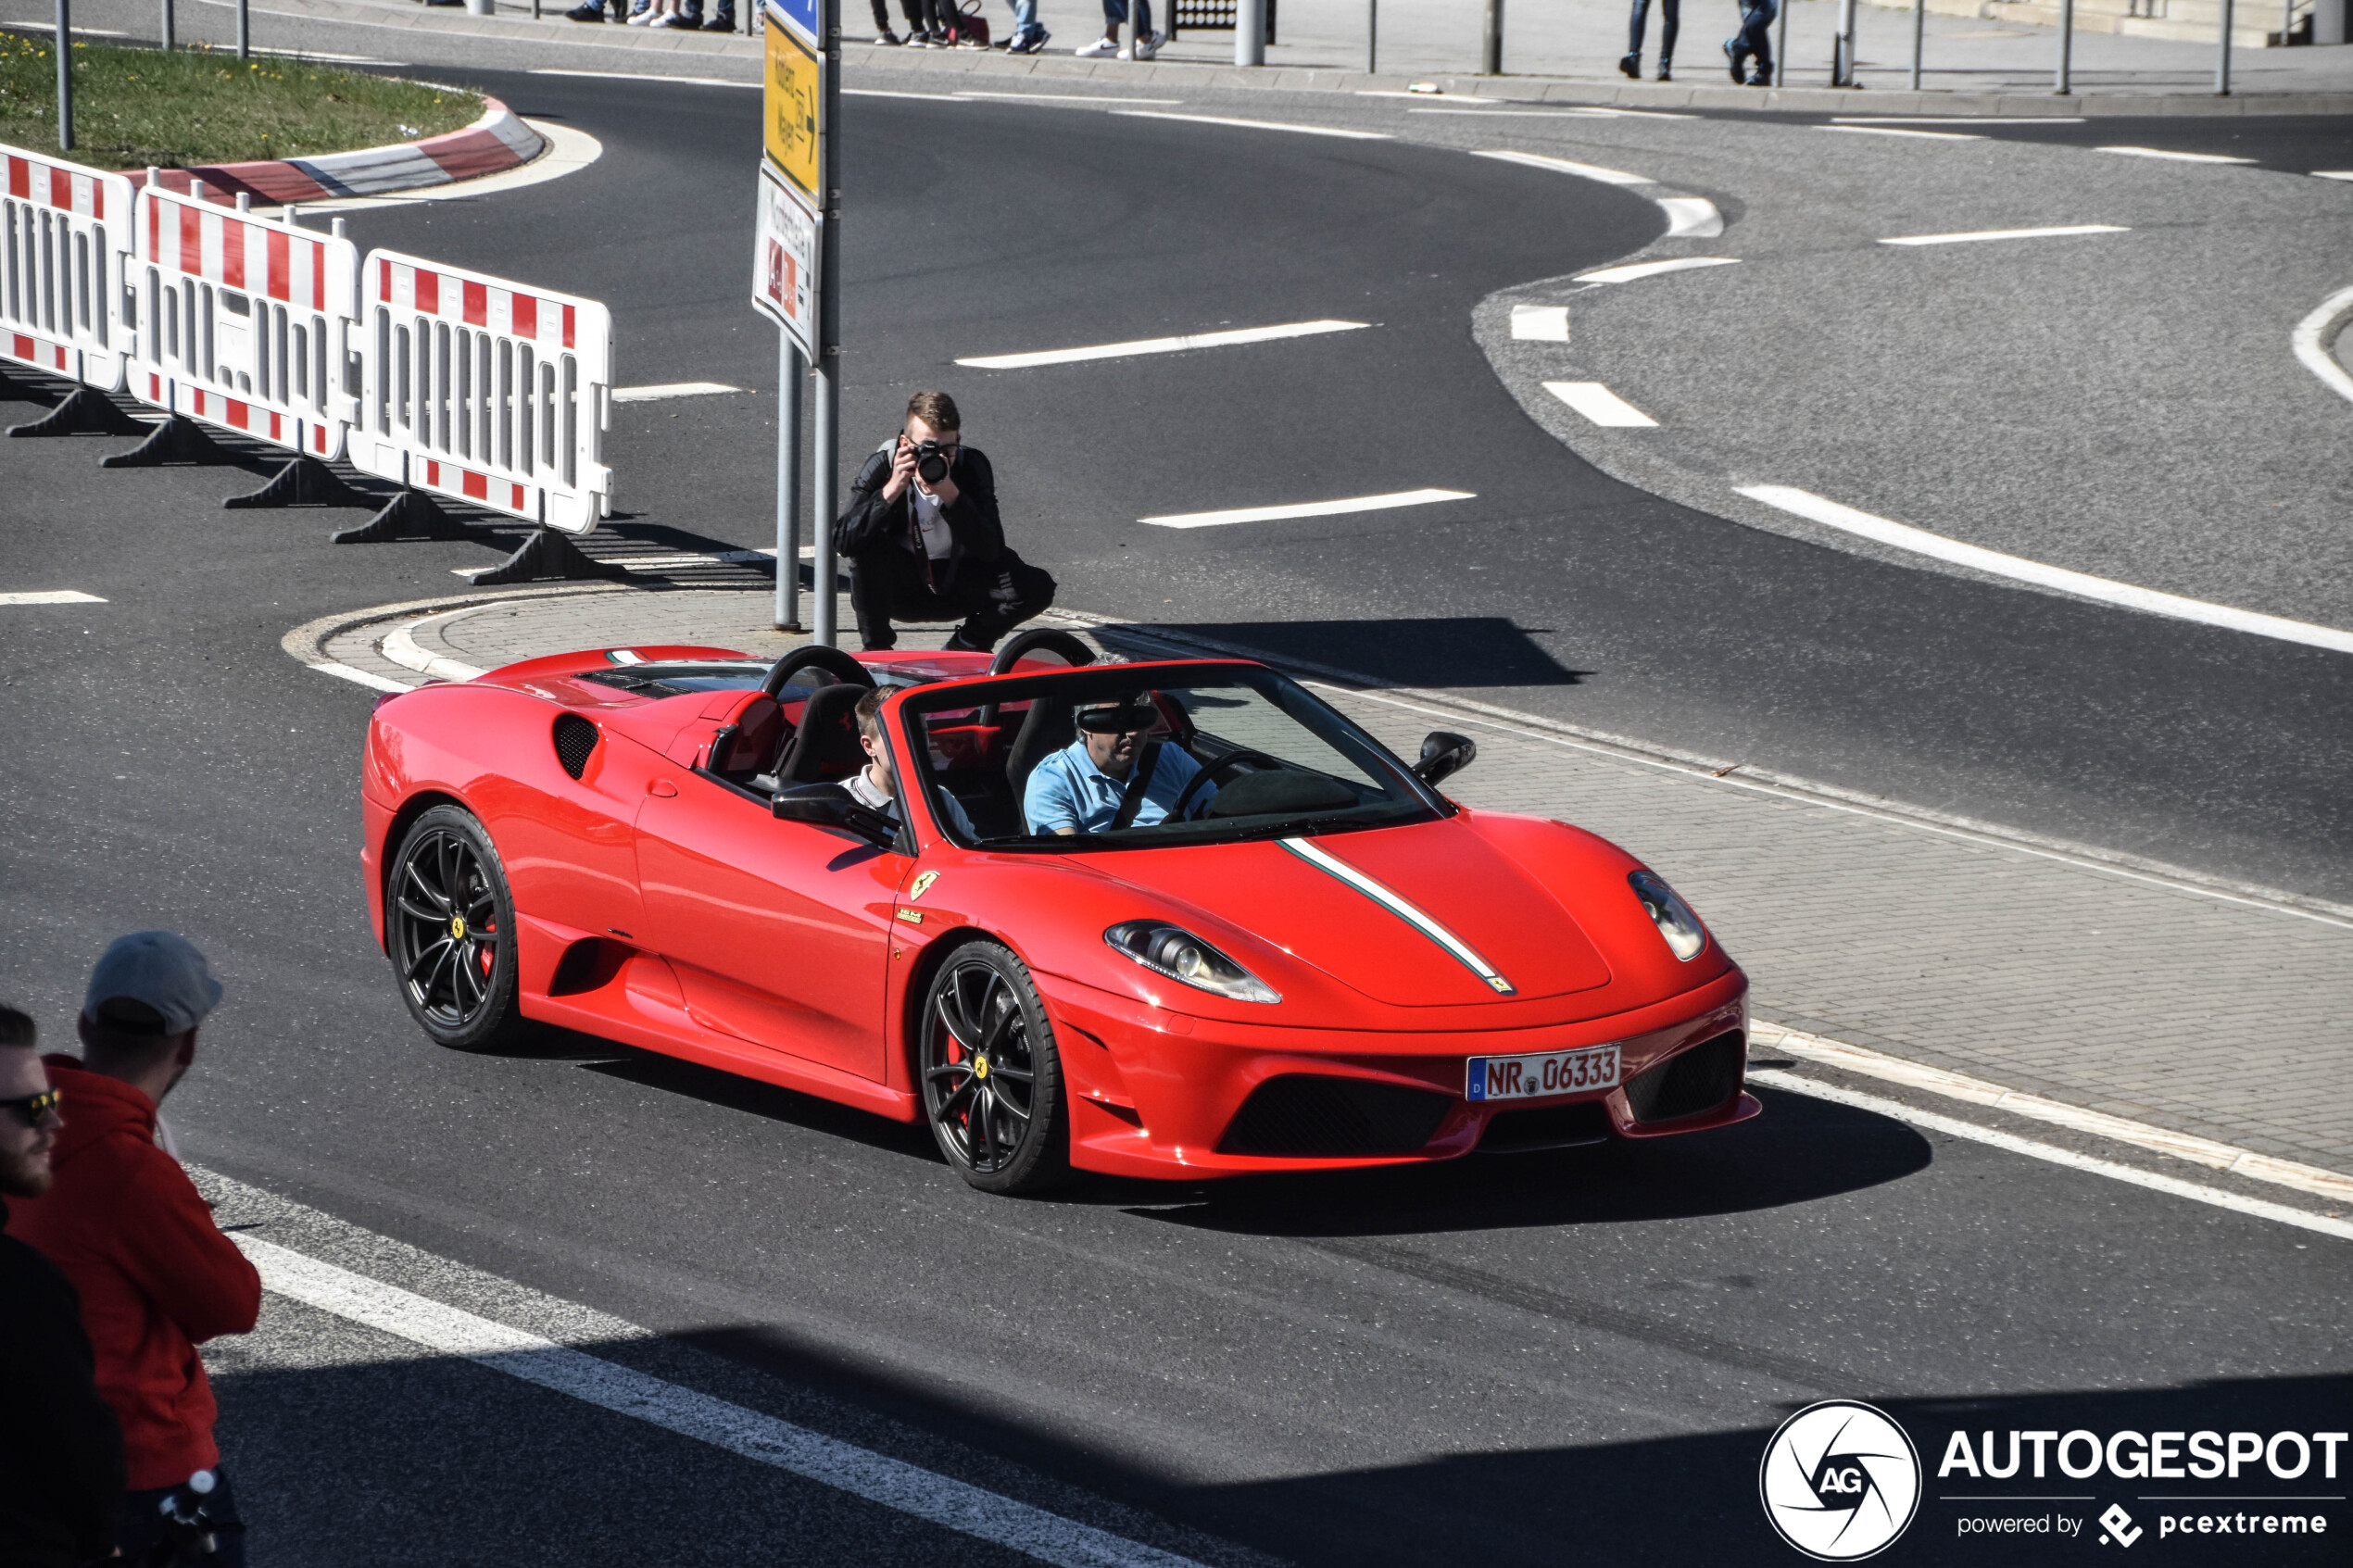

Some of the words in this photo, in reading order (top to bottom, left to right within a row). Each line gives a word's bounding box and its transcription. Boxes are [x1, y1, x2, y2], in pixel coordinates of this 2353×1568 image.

[1473, 1084, 1480, 1094] D
[1487, 1061, 1523, 1095] NR
[1542, 1051, 1616, 1090] 06333
